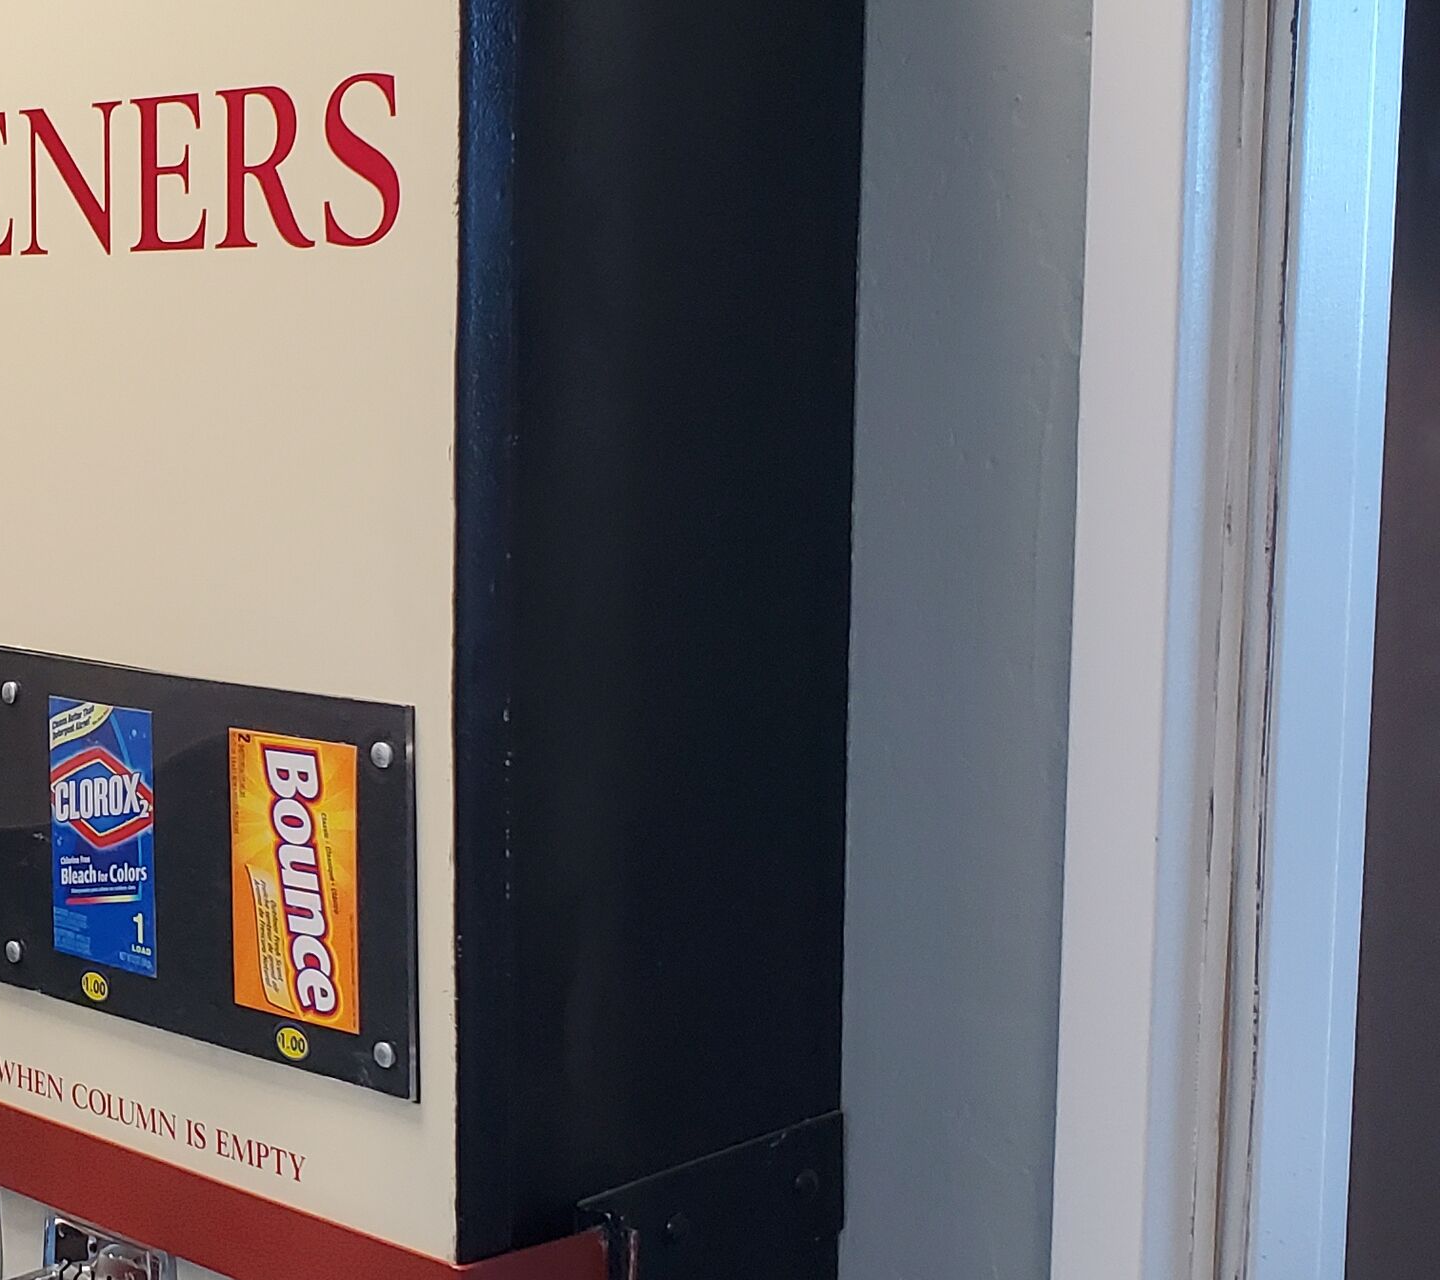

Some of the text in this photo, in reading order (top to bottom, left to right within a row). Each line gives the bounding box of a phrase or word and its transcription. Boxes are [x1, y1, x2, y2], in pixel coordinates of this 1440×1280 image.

[61, 865, 97, 885] Bleach
[109, 863, 148, 883] Colors
[263, 749, 337, 1013] Bounce
[132, 912, 144, 945] 1
[131, 943, 152, 956] LOAD
[72, 1083, 178, 1140] COLUMN
[186, 1119, 208, 1150] IS
[216, 1128, 307, 1183] EMPTY
